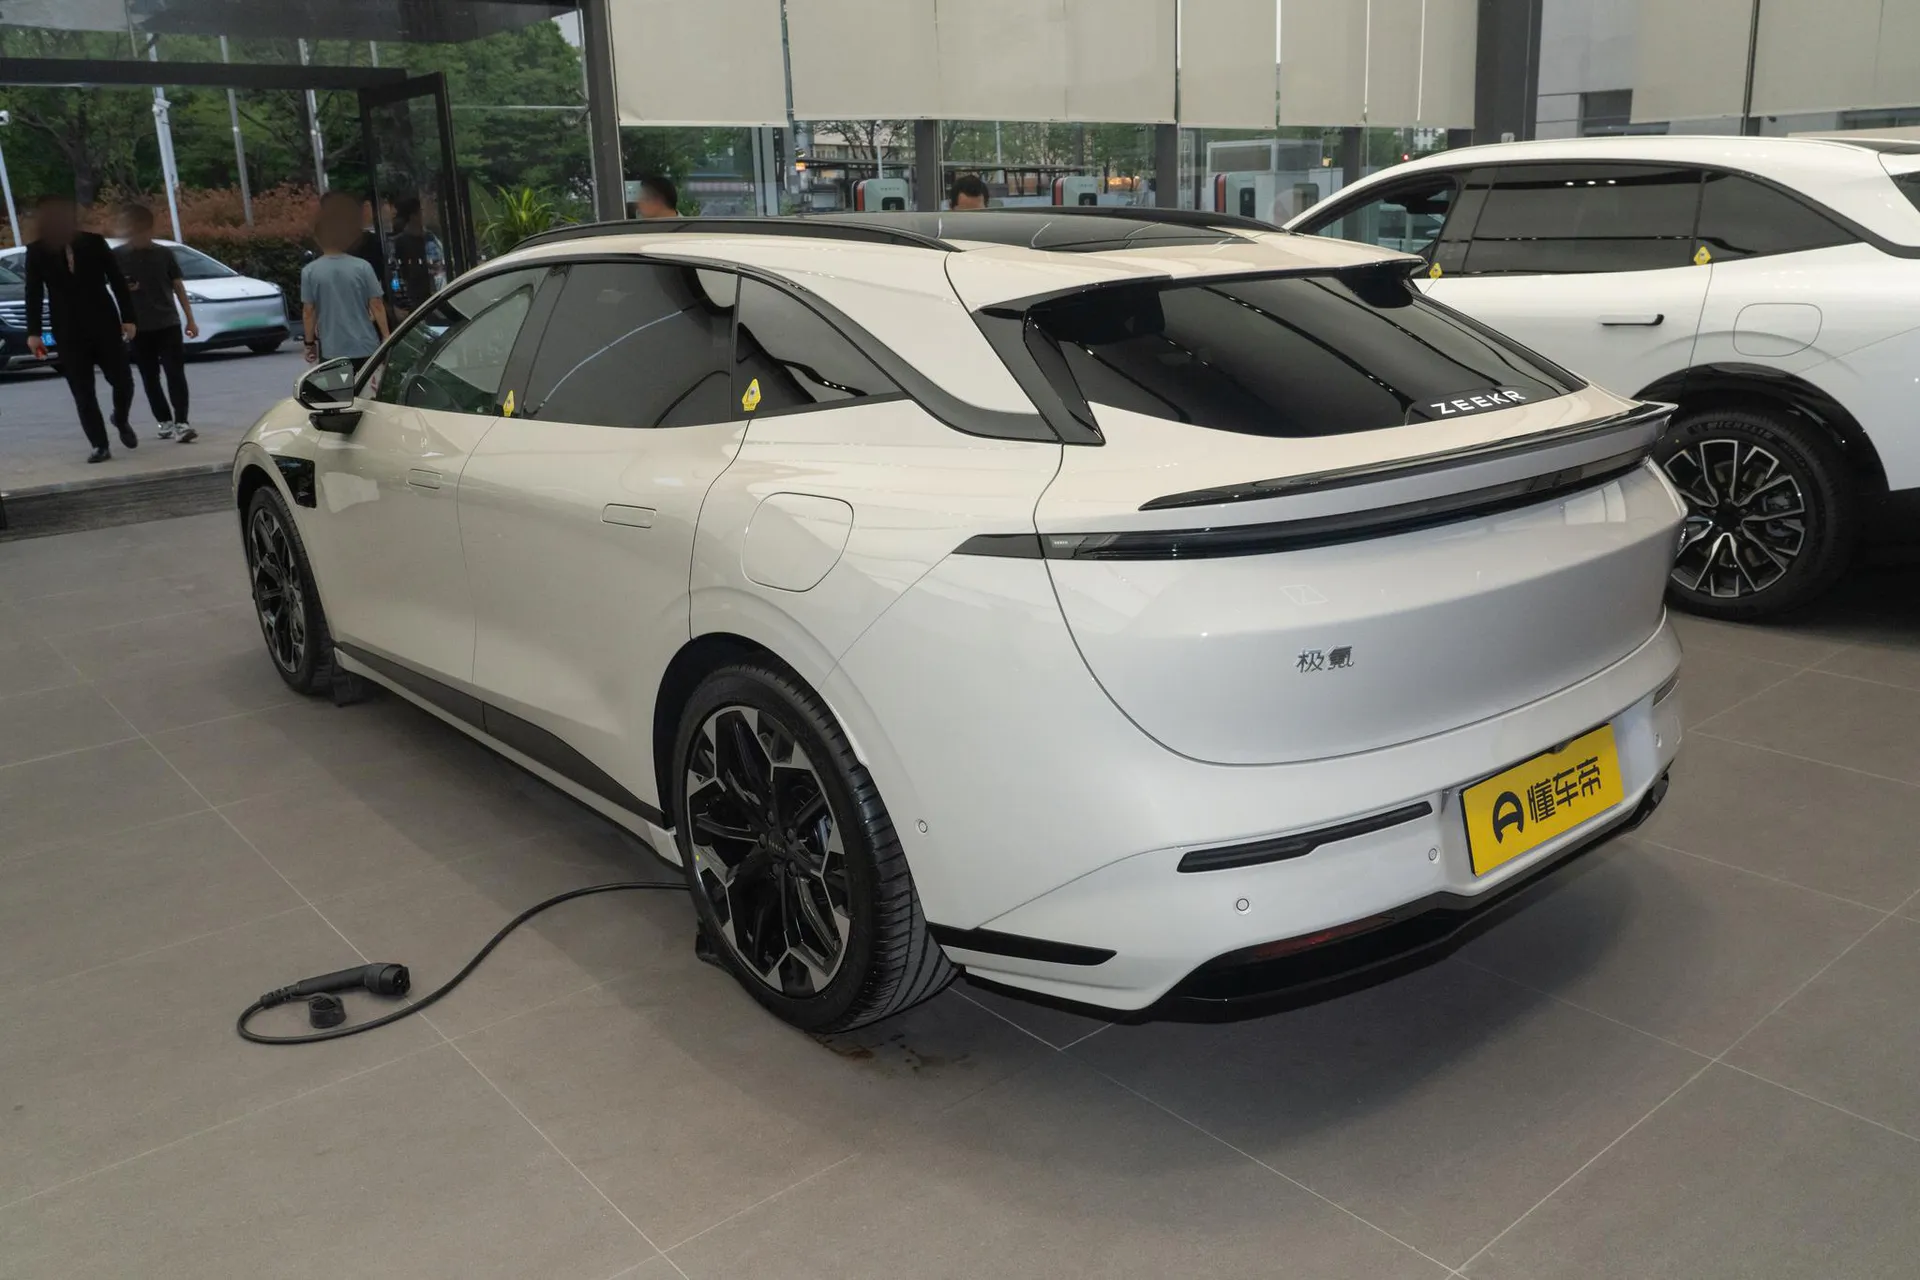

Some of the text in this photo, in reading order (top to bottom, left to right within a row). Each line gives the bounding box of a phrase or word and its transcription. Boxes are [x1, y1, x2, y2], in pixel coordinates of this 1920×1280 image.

[1430, 390, 1526, 415] ZEEKR
[1295, 645, 1355, 673] 极氪
[1526, 756, 1602, 824] 懂车帝
